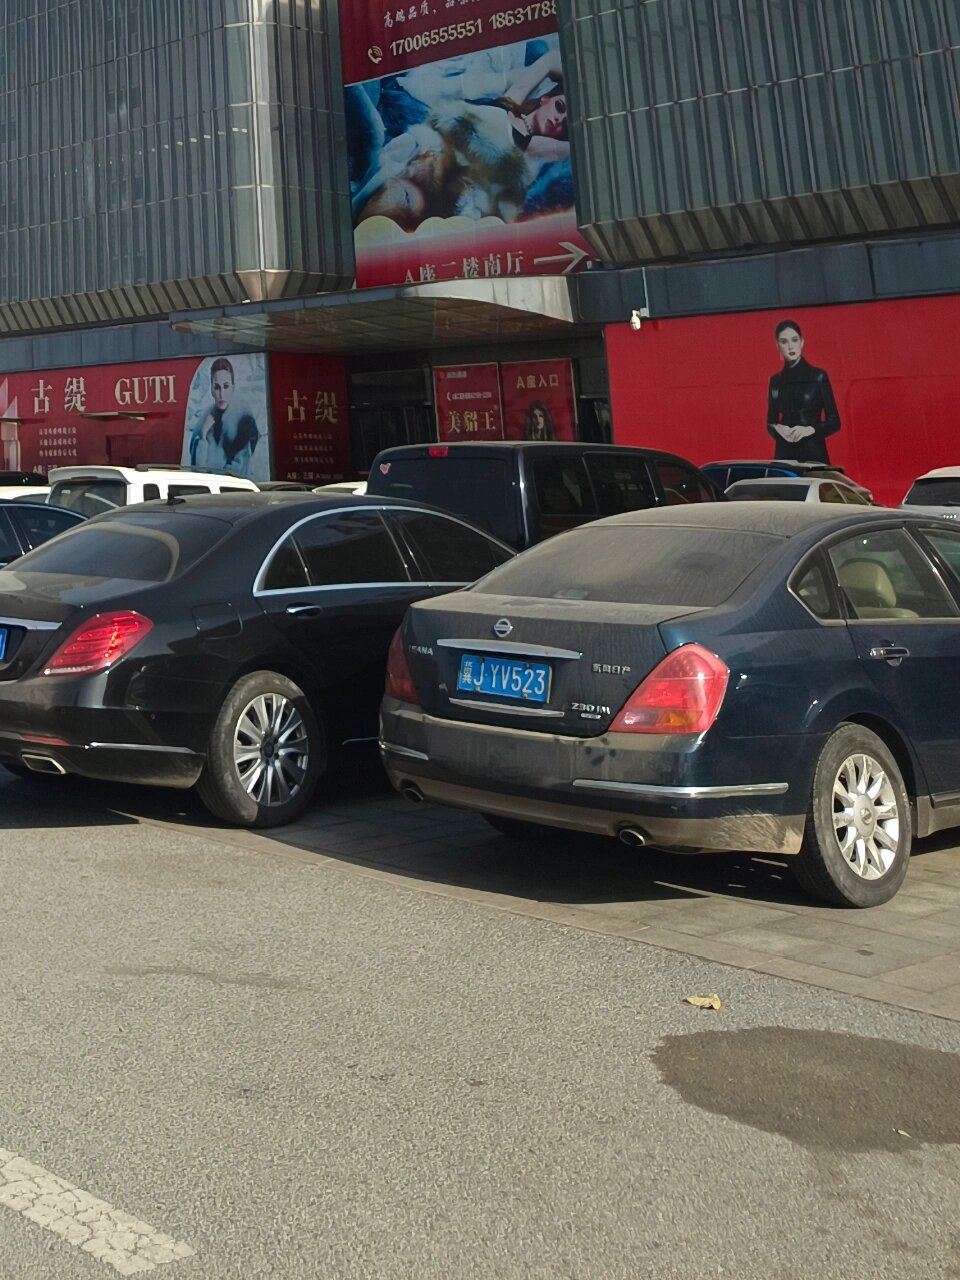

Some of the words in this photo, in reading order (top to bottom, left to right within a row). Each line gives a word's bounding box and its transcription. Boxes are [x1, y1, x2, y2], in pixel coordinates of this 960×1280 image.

[389, 18, 483, 56] 17006555551
[114, 375, 177, 406] GUTI
[515, 373, 559, 389] A座入口
